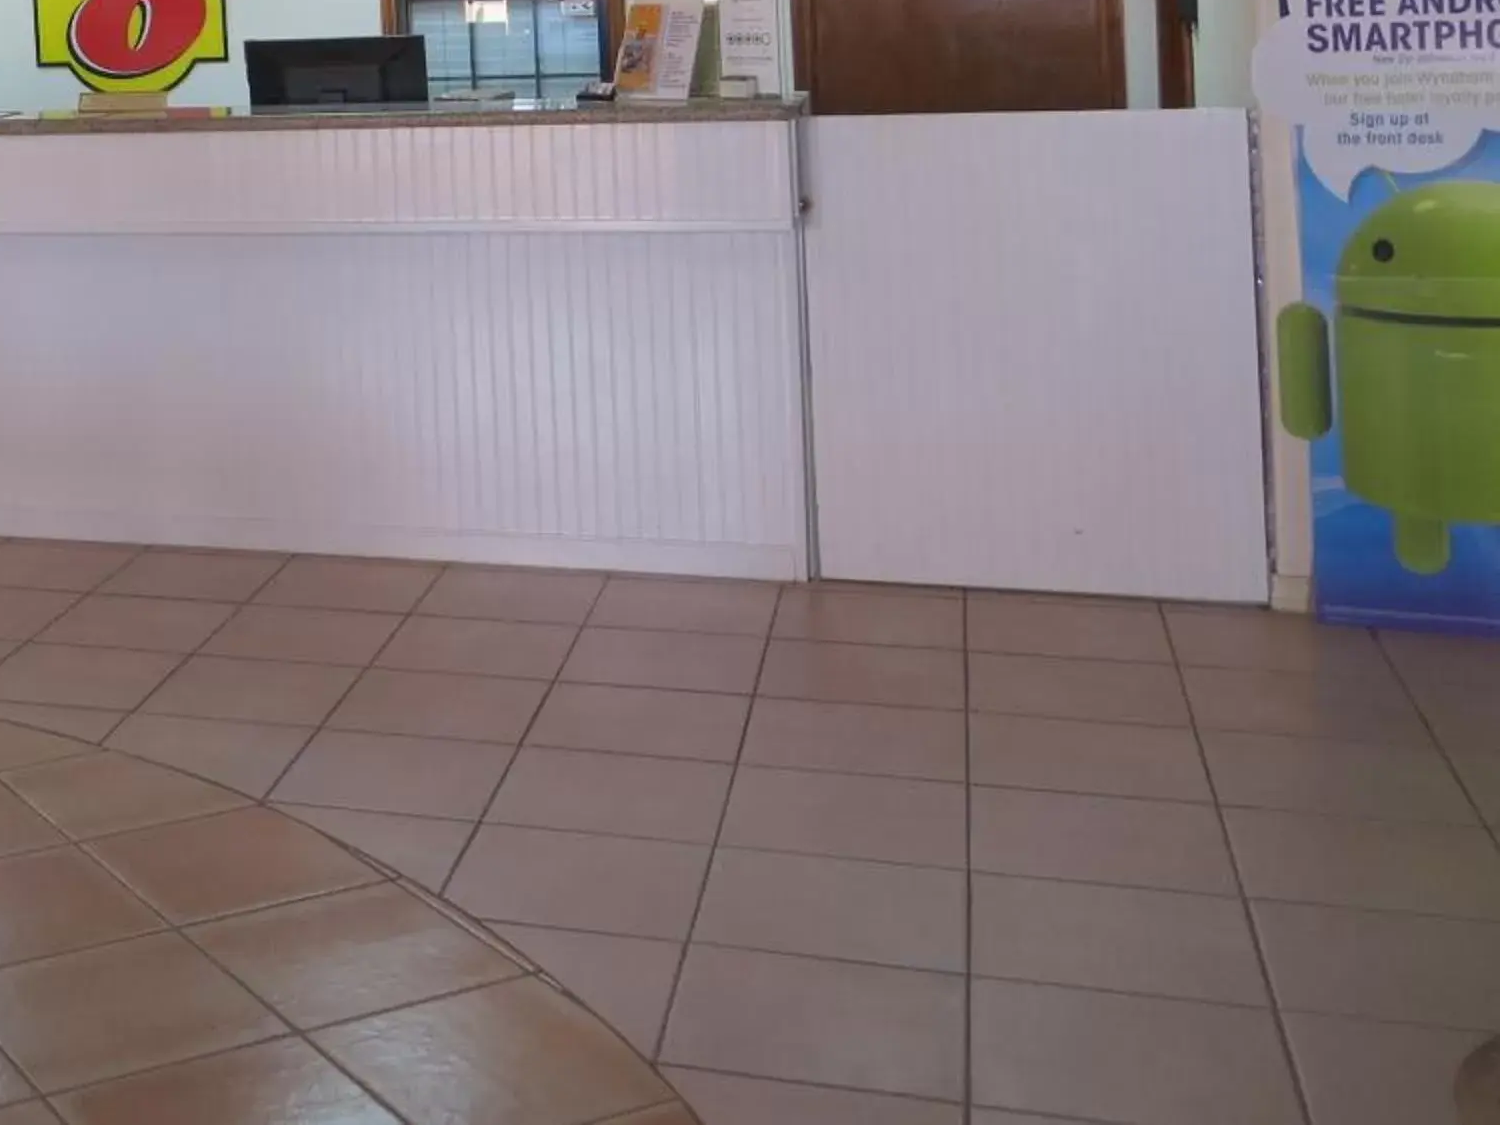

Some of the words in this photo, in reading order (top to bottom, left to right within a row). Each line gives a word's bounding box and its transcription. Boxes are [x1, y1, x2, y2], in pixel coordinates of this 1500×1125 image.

[1306, 73, 1349, 87] When
[1354, 74, 1380, 89] you
[1417, 71, 1494, 89] Wyndham
[1353, 92, 1382, 105] free
[1349, 111, 1385, 128] Sign
[1389, 114, 1409, 127] up
[1414, 111, 1430, 125] at
[1336, 132, 1361, 145] the
[1366, 131, 1403, 145] front
[1407, 129, 1444, 145] desk
